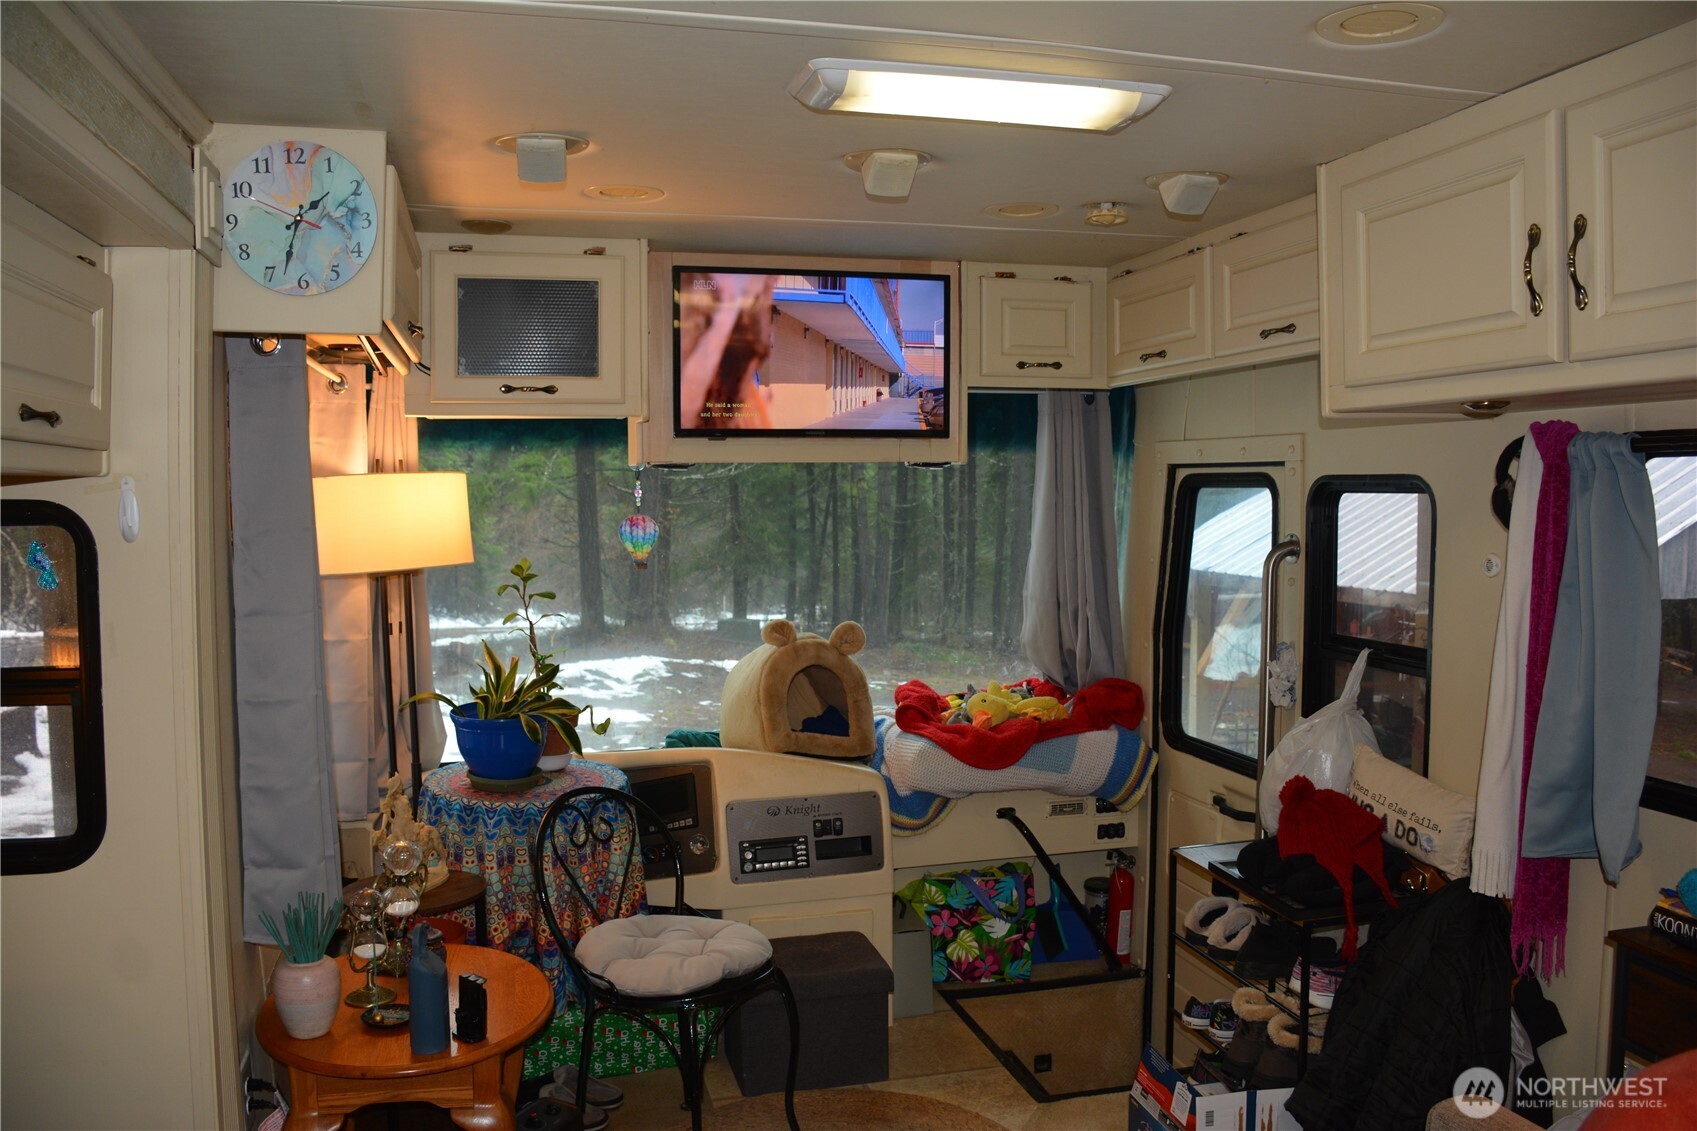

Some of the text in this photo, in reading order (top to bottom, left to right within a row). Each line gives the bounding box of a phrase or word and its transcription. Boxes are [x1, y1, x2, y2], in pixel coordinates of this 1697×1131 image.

[251, 156, 272, 174] 11
[283, 147, 307, 165] 12
[324, 156, 334, 173] 1
[231, 180, 253, 199] 10
[349, 179, 363, 197] 2
[225, 213, 239, 232] 9
[361, 211, 372, 230] 3
[238, 243, 251, 261] 8
[350, 241, 363, 258] 4
[264, 265, 277, 283] 7
[297, 272, 310, 290] 6
[329, 263, 340, 282] 5
[693, 279, 717, 291] HLN
[785, 803, 821, 816] Knight
[1371, 793, 1387, 807] all
[1388, 802, 1408, 817] else
[1409, 812, 1442, 833] fails,
